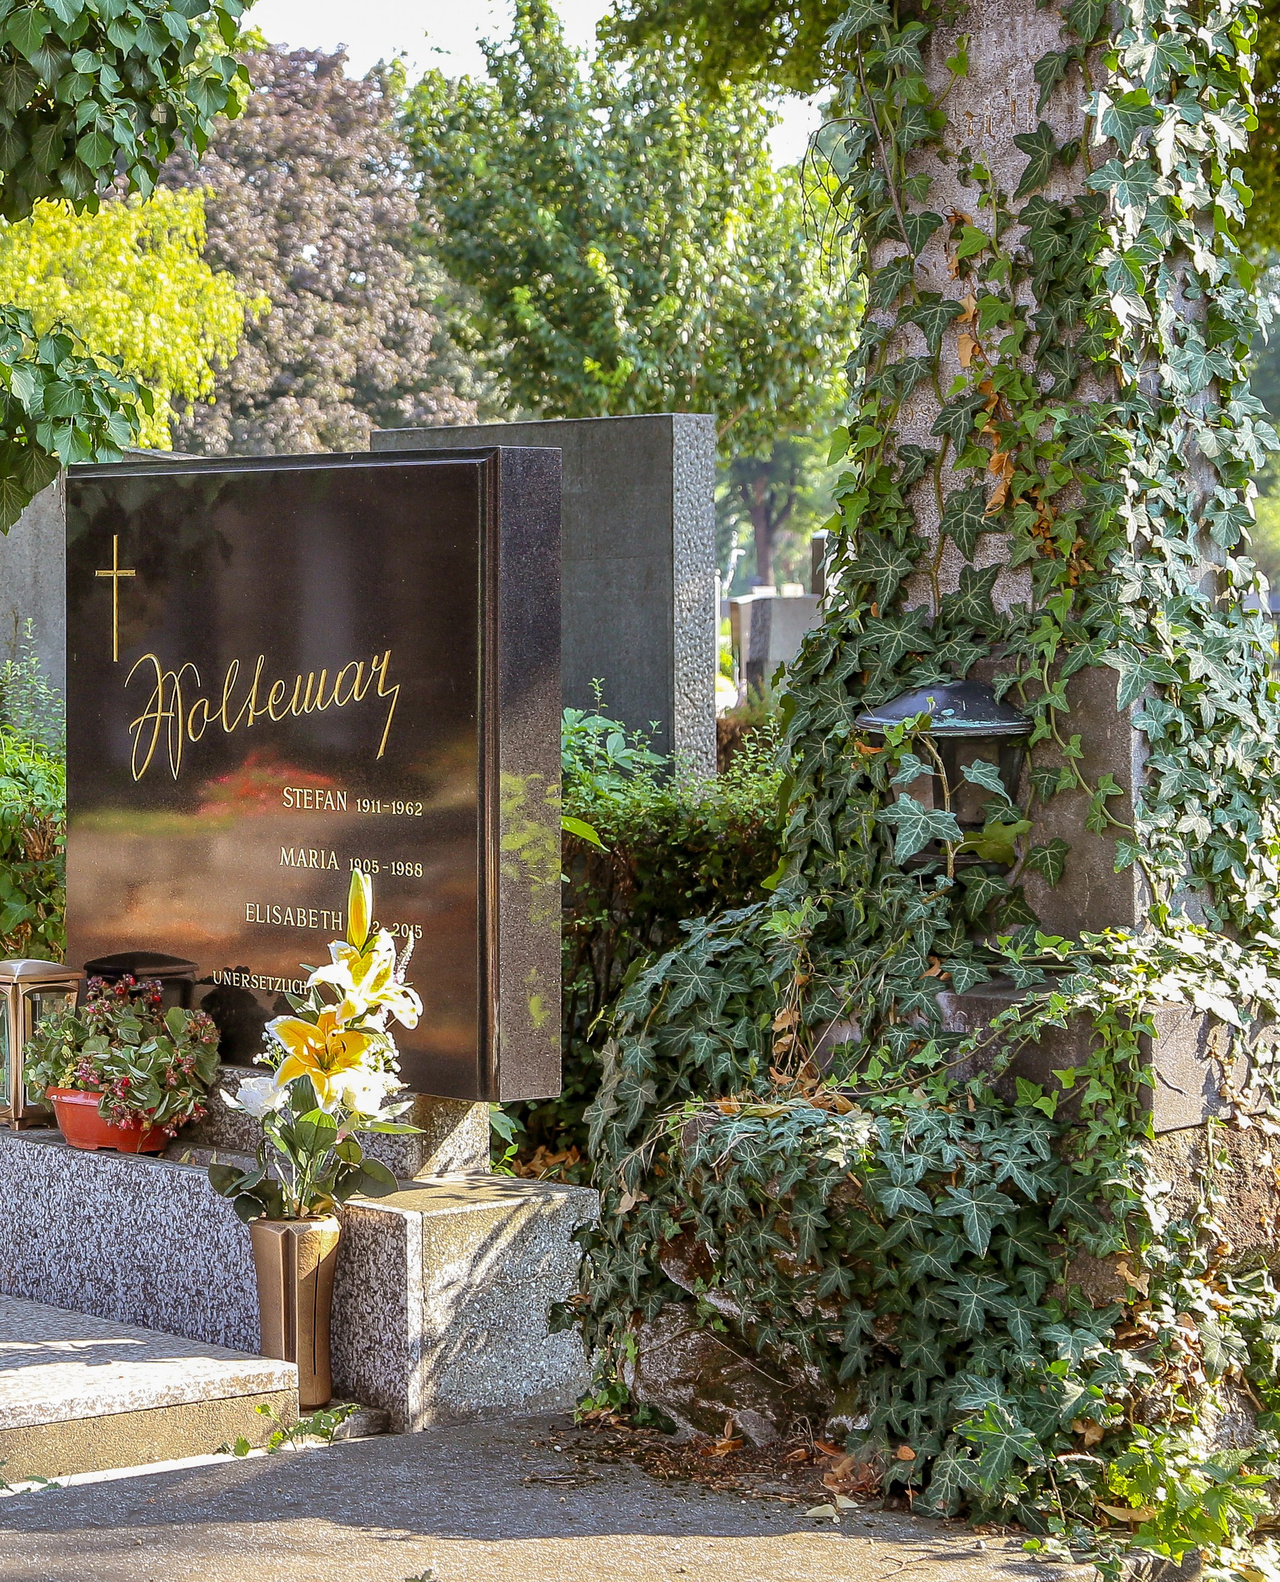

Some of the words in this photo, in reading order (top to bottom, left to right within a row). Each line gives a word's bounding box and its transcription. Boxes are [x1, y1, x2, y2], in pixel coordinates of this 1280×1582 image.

[282, 786, 348, 812] STEFAN
[356, 798, 424, 817] 1911-1962
[279, 846, 340, 871] MARIA
[245, 902, 343, 931] ELISABETH
[212, 970, 308, 995] UNERSETZLICH
